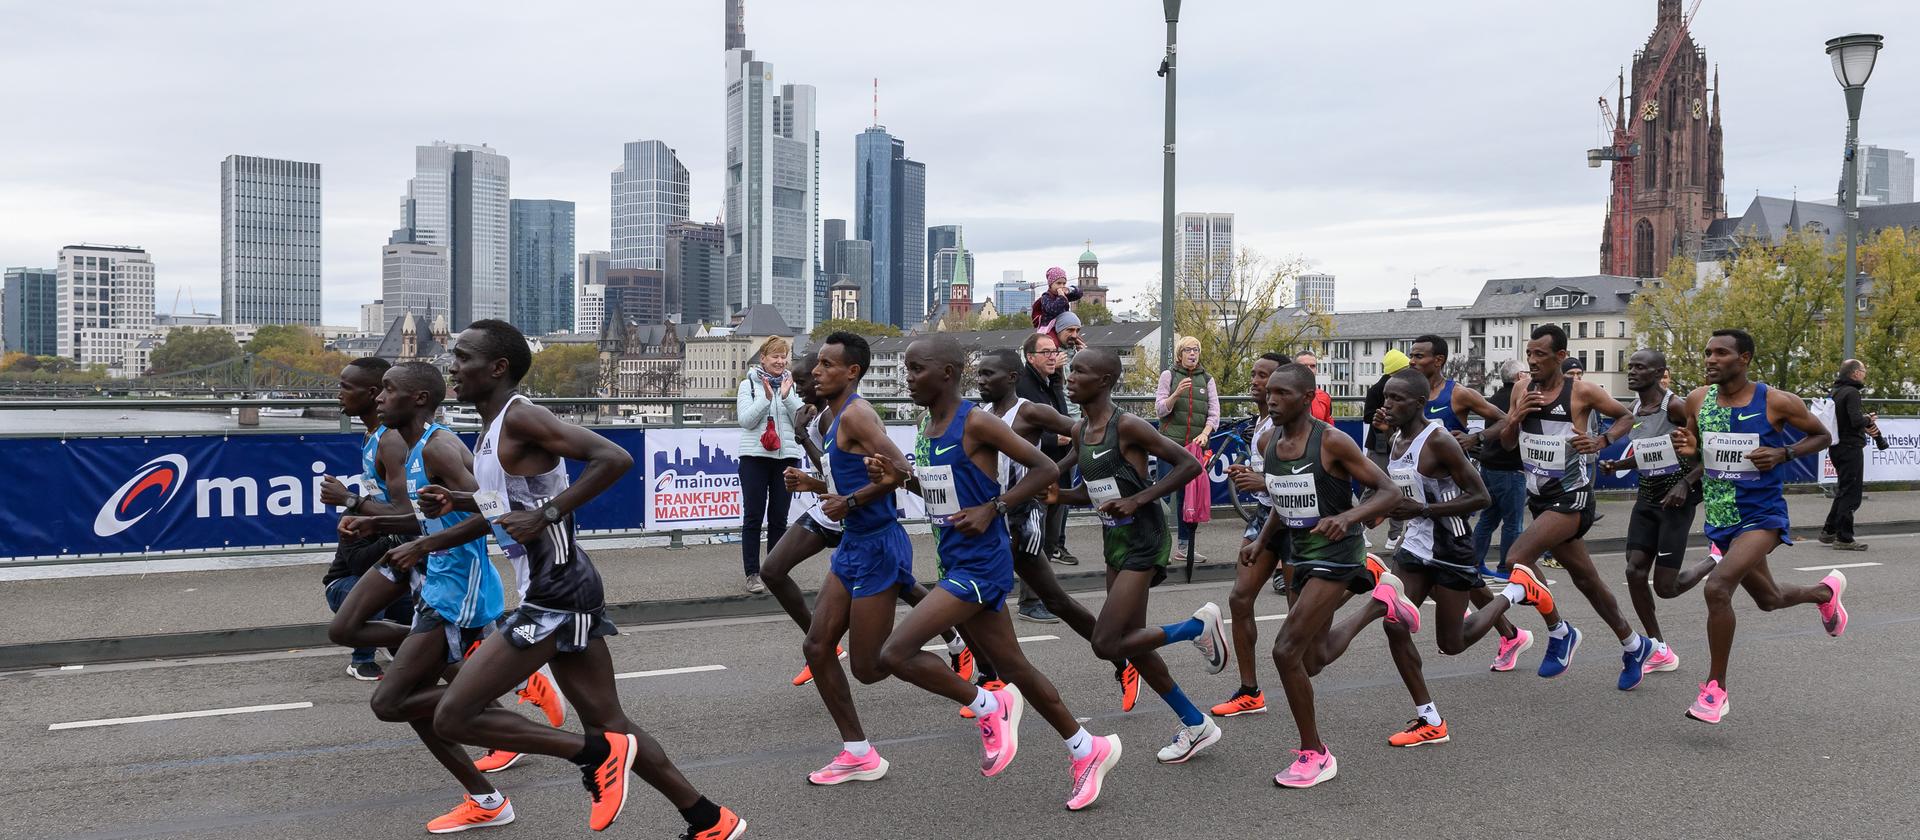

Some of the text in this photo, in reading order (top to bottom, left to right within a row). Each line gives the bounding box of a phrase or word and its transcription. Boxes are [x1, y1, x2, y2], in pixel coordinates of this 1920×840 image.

[1529, 438, 1560, 446] mainova
[1527, 448, 1555, 462] TEBALU
[1643, 451, 1663, 462] MARK
[1715, 450, 1743, 463] FIKRE
[675, 475, 740, 489] mainova
[1274, 480, 1309, 488] mainova
[196, 461, 372, 518] main
[655, 491, 739, 506] FRANKFURT
[655, 504, 740, 519] MARATHON
